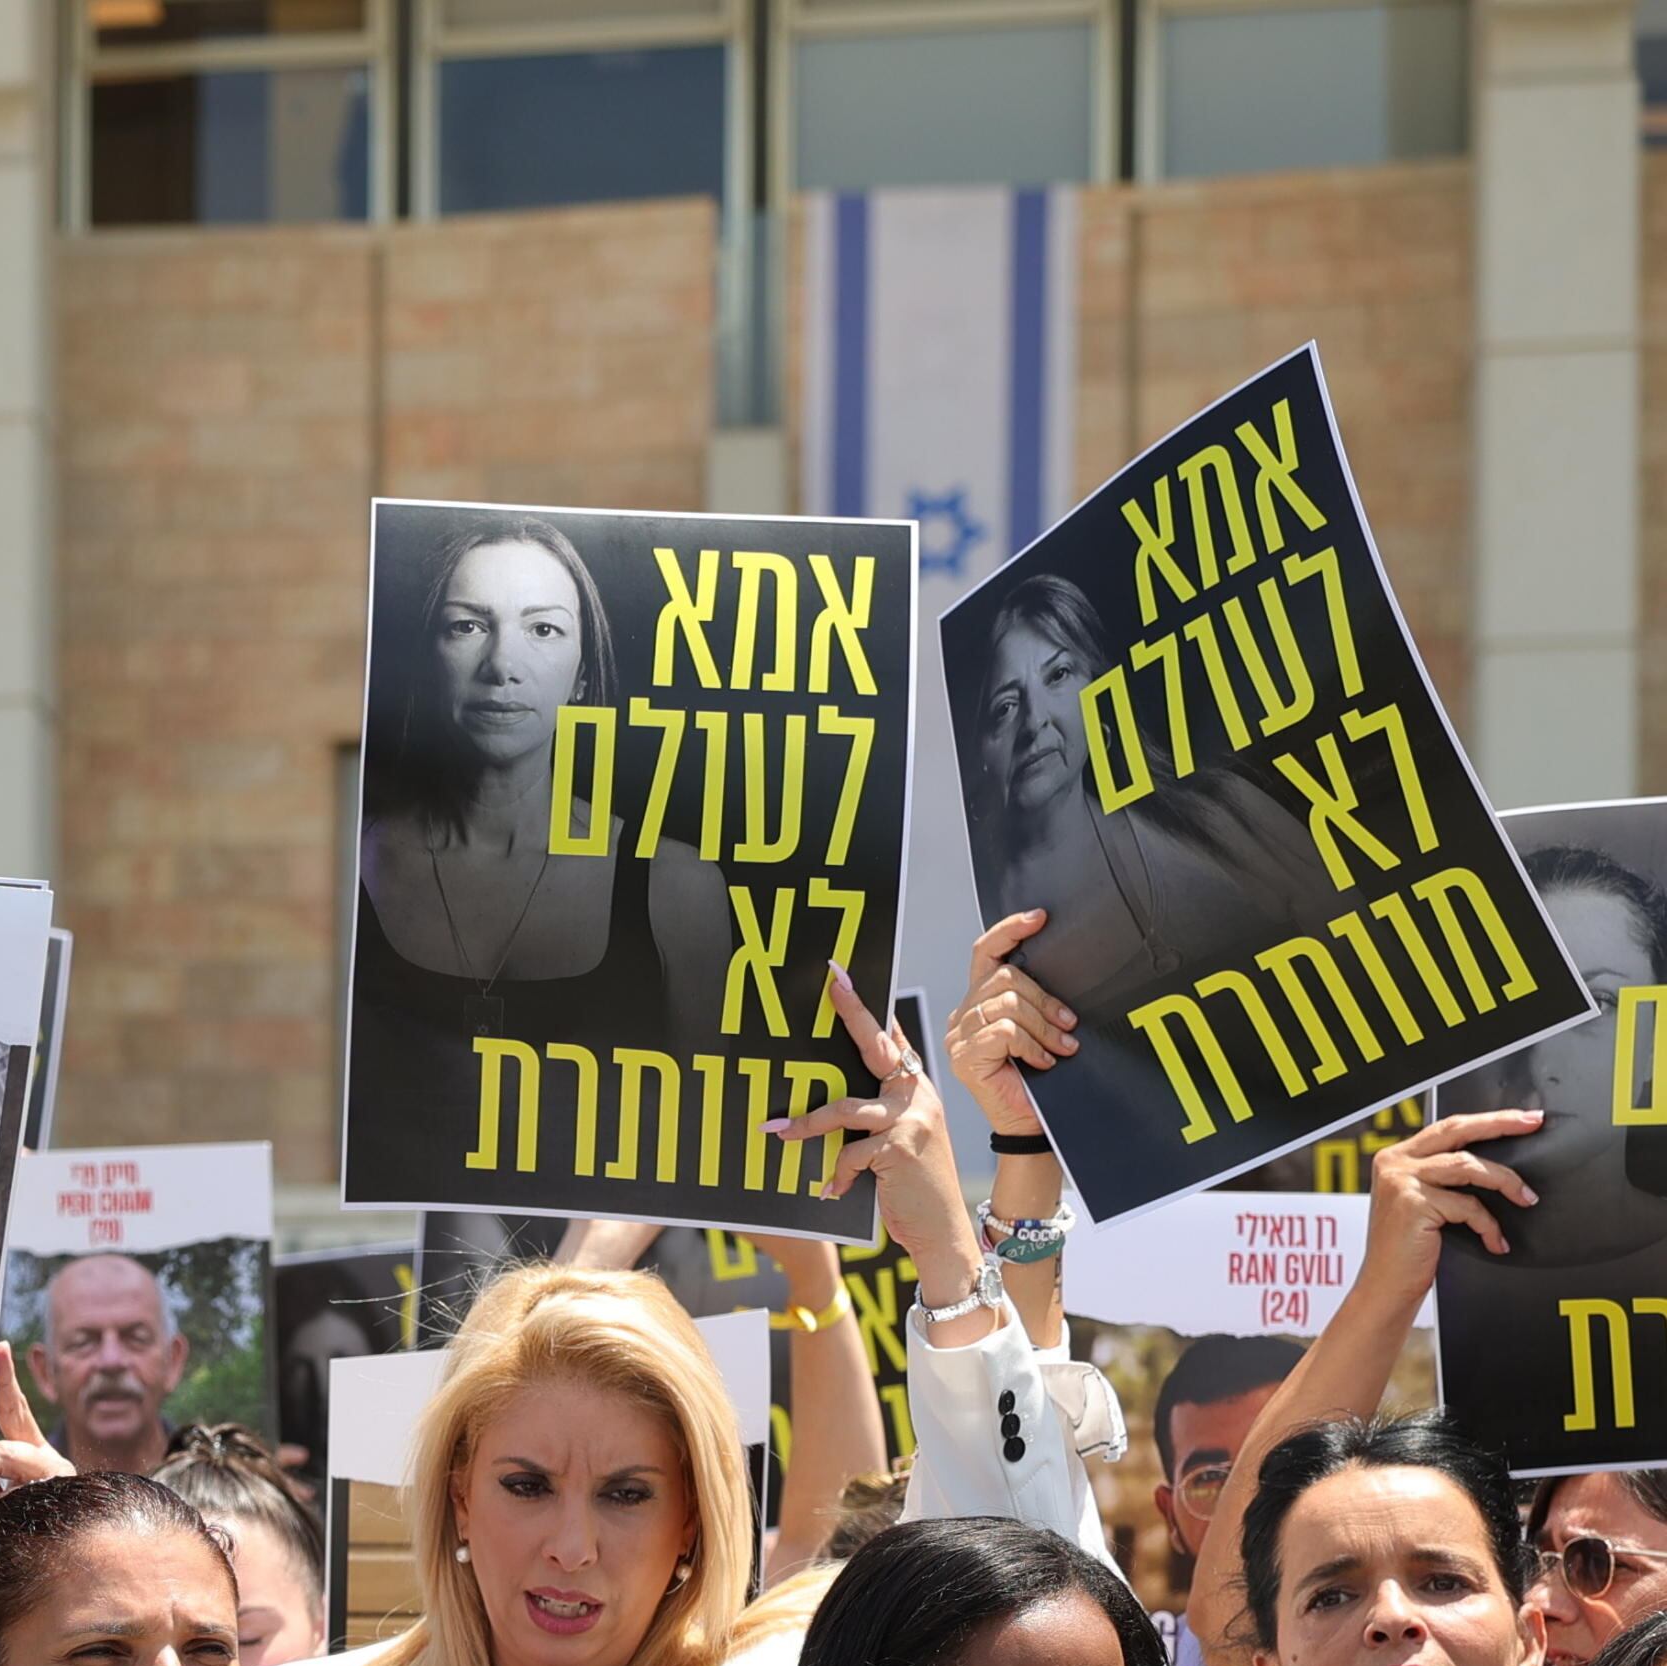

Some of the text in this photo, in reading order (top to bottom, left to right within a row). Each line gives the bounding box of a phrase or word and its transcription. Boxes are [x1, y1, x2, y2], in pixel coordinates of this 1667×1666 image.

[1121, 397, 1328, 627] אמא
[653, 547, 878, 695] אמא
[1079, 545, 1365, 816] לעולם
[549, 697, 875, 866] לעולם
[1272, 703, 1440, 892] לא
[721, 877, 865, 1038] לא
[1127, 867, 1540, 1145] מוותרת
[466, 1037, 849, 1200] מוותרת
[1228, 1253, 1344, 1286] RAN GVILI
[1261, 1289, 1309, 1327] (24)
[1316, 1215, 1338, 1250] רן
